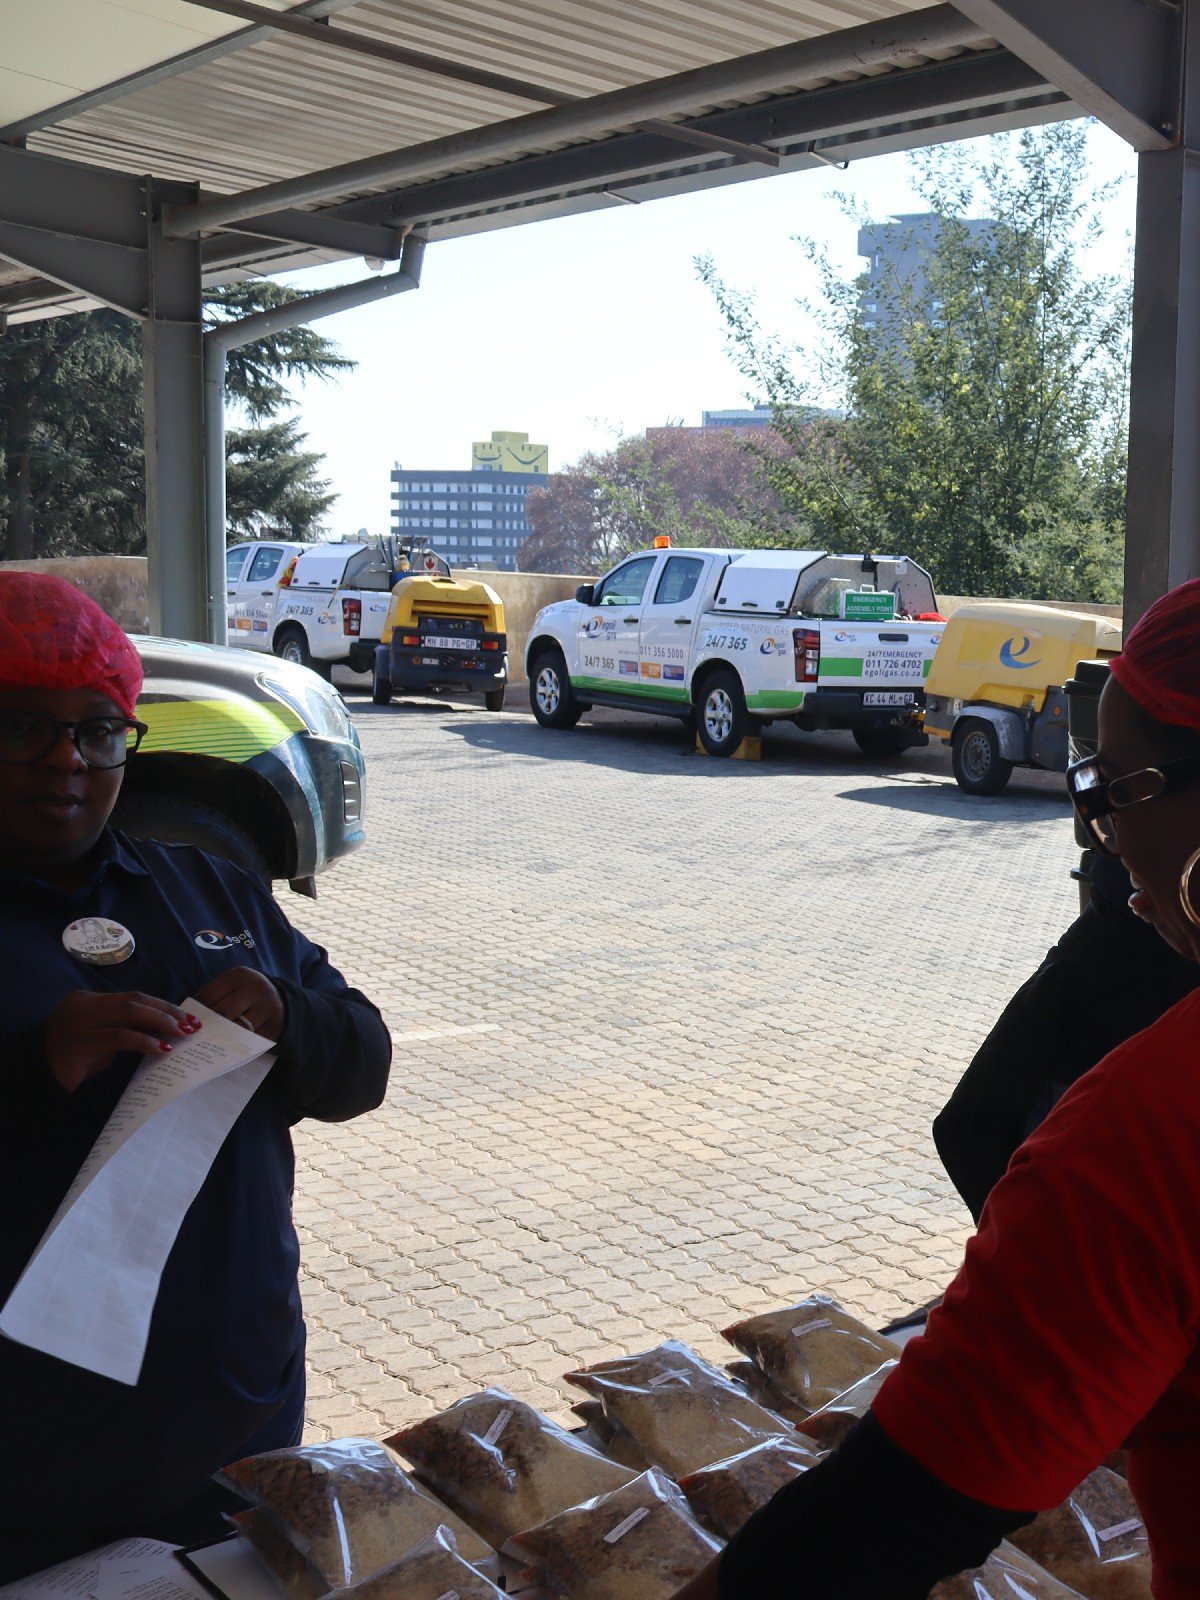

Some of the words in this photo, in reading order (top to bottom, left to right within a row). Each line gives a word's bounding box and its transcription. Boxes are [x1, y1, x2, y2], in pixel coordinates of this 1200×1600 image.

[705, 635, 728, 648] 24/7
[728, 637, 748, 650] 365
[640, 646, 651, 657] 011
[653, 646, 665, 658] 356
[667, 648, 684, 659] 5000
[584, 656, 600, 668] 24/7
[601, 657, 615, 669] 365
[865, 659, 881, 668] 011
[884, 660, 899, 669] 726
[901, 660, 922, 669] 4702
